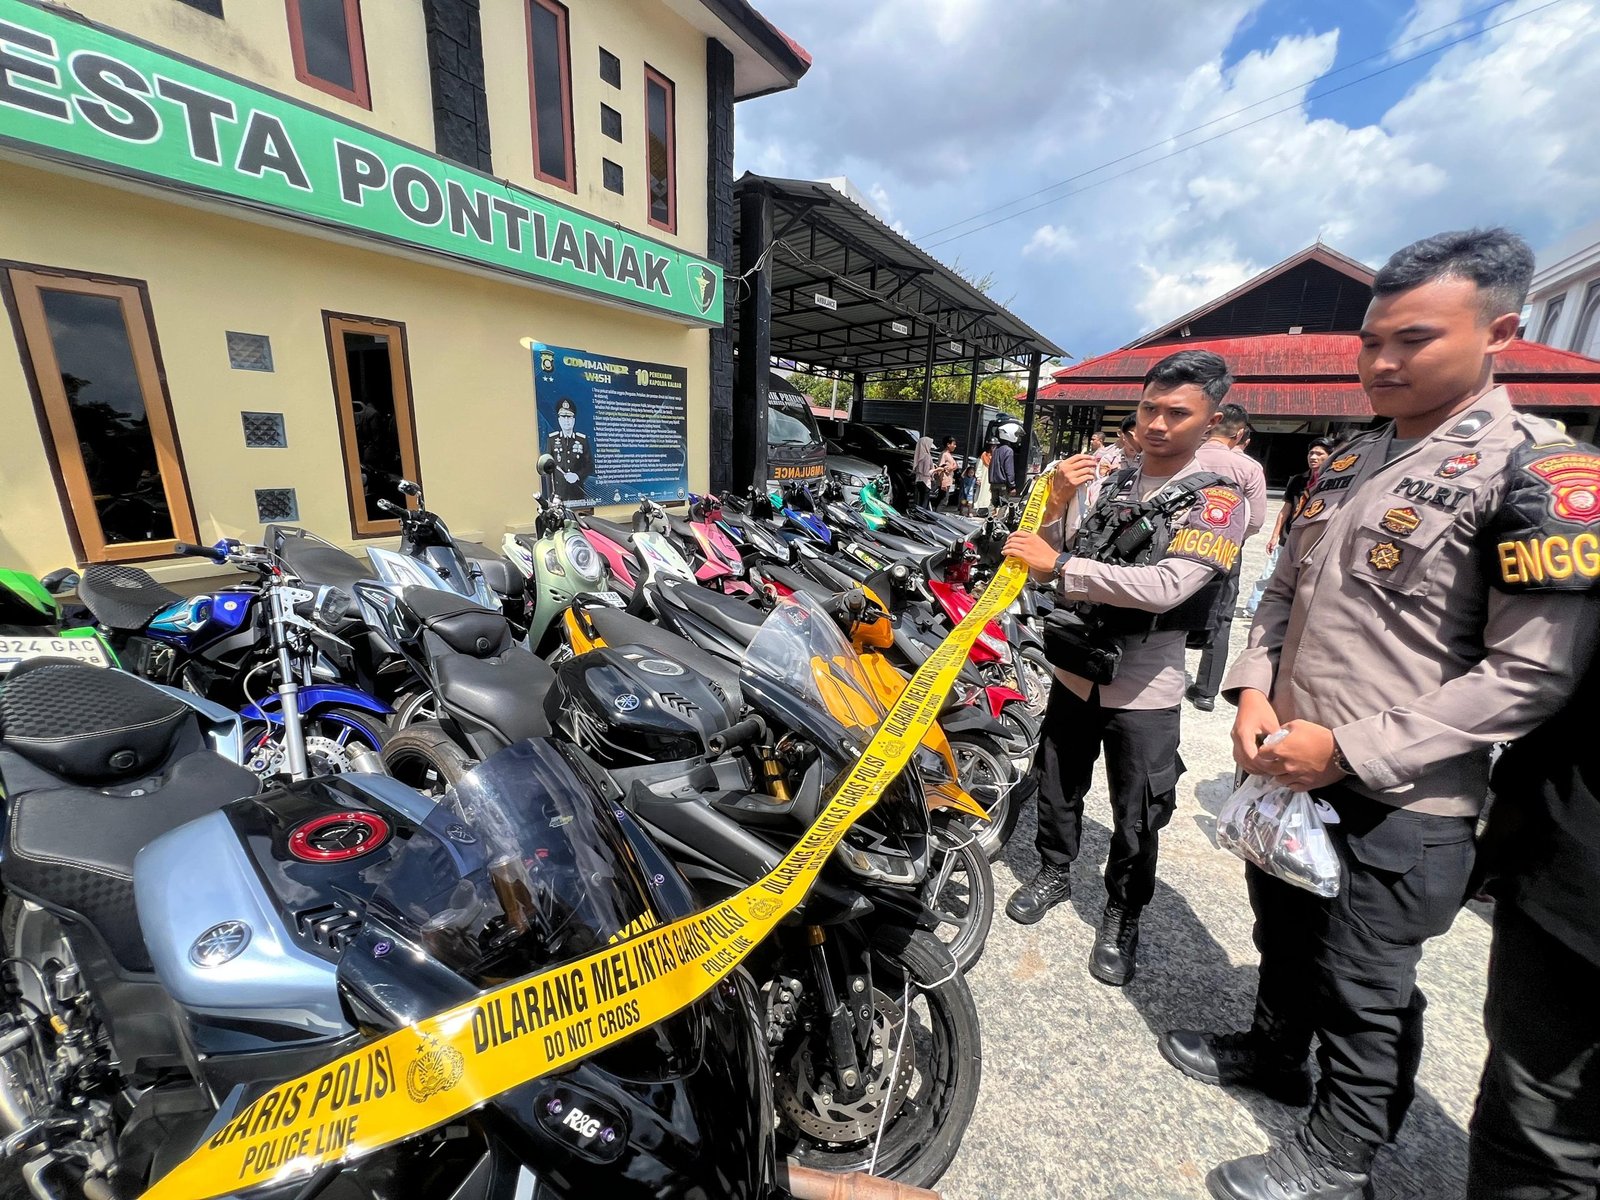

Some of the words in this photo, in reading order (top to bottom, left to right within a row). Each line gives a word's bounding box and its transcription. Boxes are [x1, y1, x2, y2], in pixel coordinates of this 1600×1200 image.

[334, 139, 672, 297] PONTIANAK
[563, 356, 629, 375] COMMANDER
[584, 371, 612, 384] WISH
[635, 369, 649, 386] 10
[1392, 476, 1468, 510] POLRI
[1498, 533, 1600, 583] ENGG
[51, 640, 95, 652] GAC
[884, 700, 920, 738] DILARANG
[905, 668, 939, 704] MELINTAS
[762, 850, 815, 895] DILARANG
[801, 806, 851, 849] MELINTAS
[835, 781, 869, 808] GARIS
[855, 754, 887, 784] POLISI
[471, 968, 588, 1054] DILARANG
[591, 932, 678, 1004] MELINTAS
[672, 921, 710, 965] GARIS
[699, 904, 748, 946] POLISI
[702, 947, 737, 977] POLICE
[732, 935, 754, 954] LINE
[543, 1030, 565, 1062] DO
[566, 1018, 593, 1052] NOT
[597, 998, 640, 1038] CROSS
[308, 1046, 396, 1119] POLISI
[238, 1128, 313, 1180] POLICE
[314, 1114, 359, 1157] LINE
[562, 1107, 601, 1138] R&G
